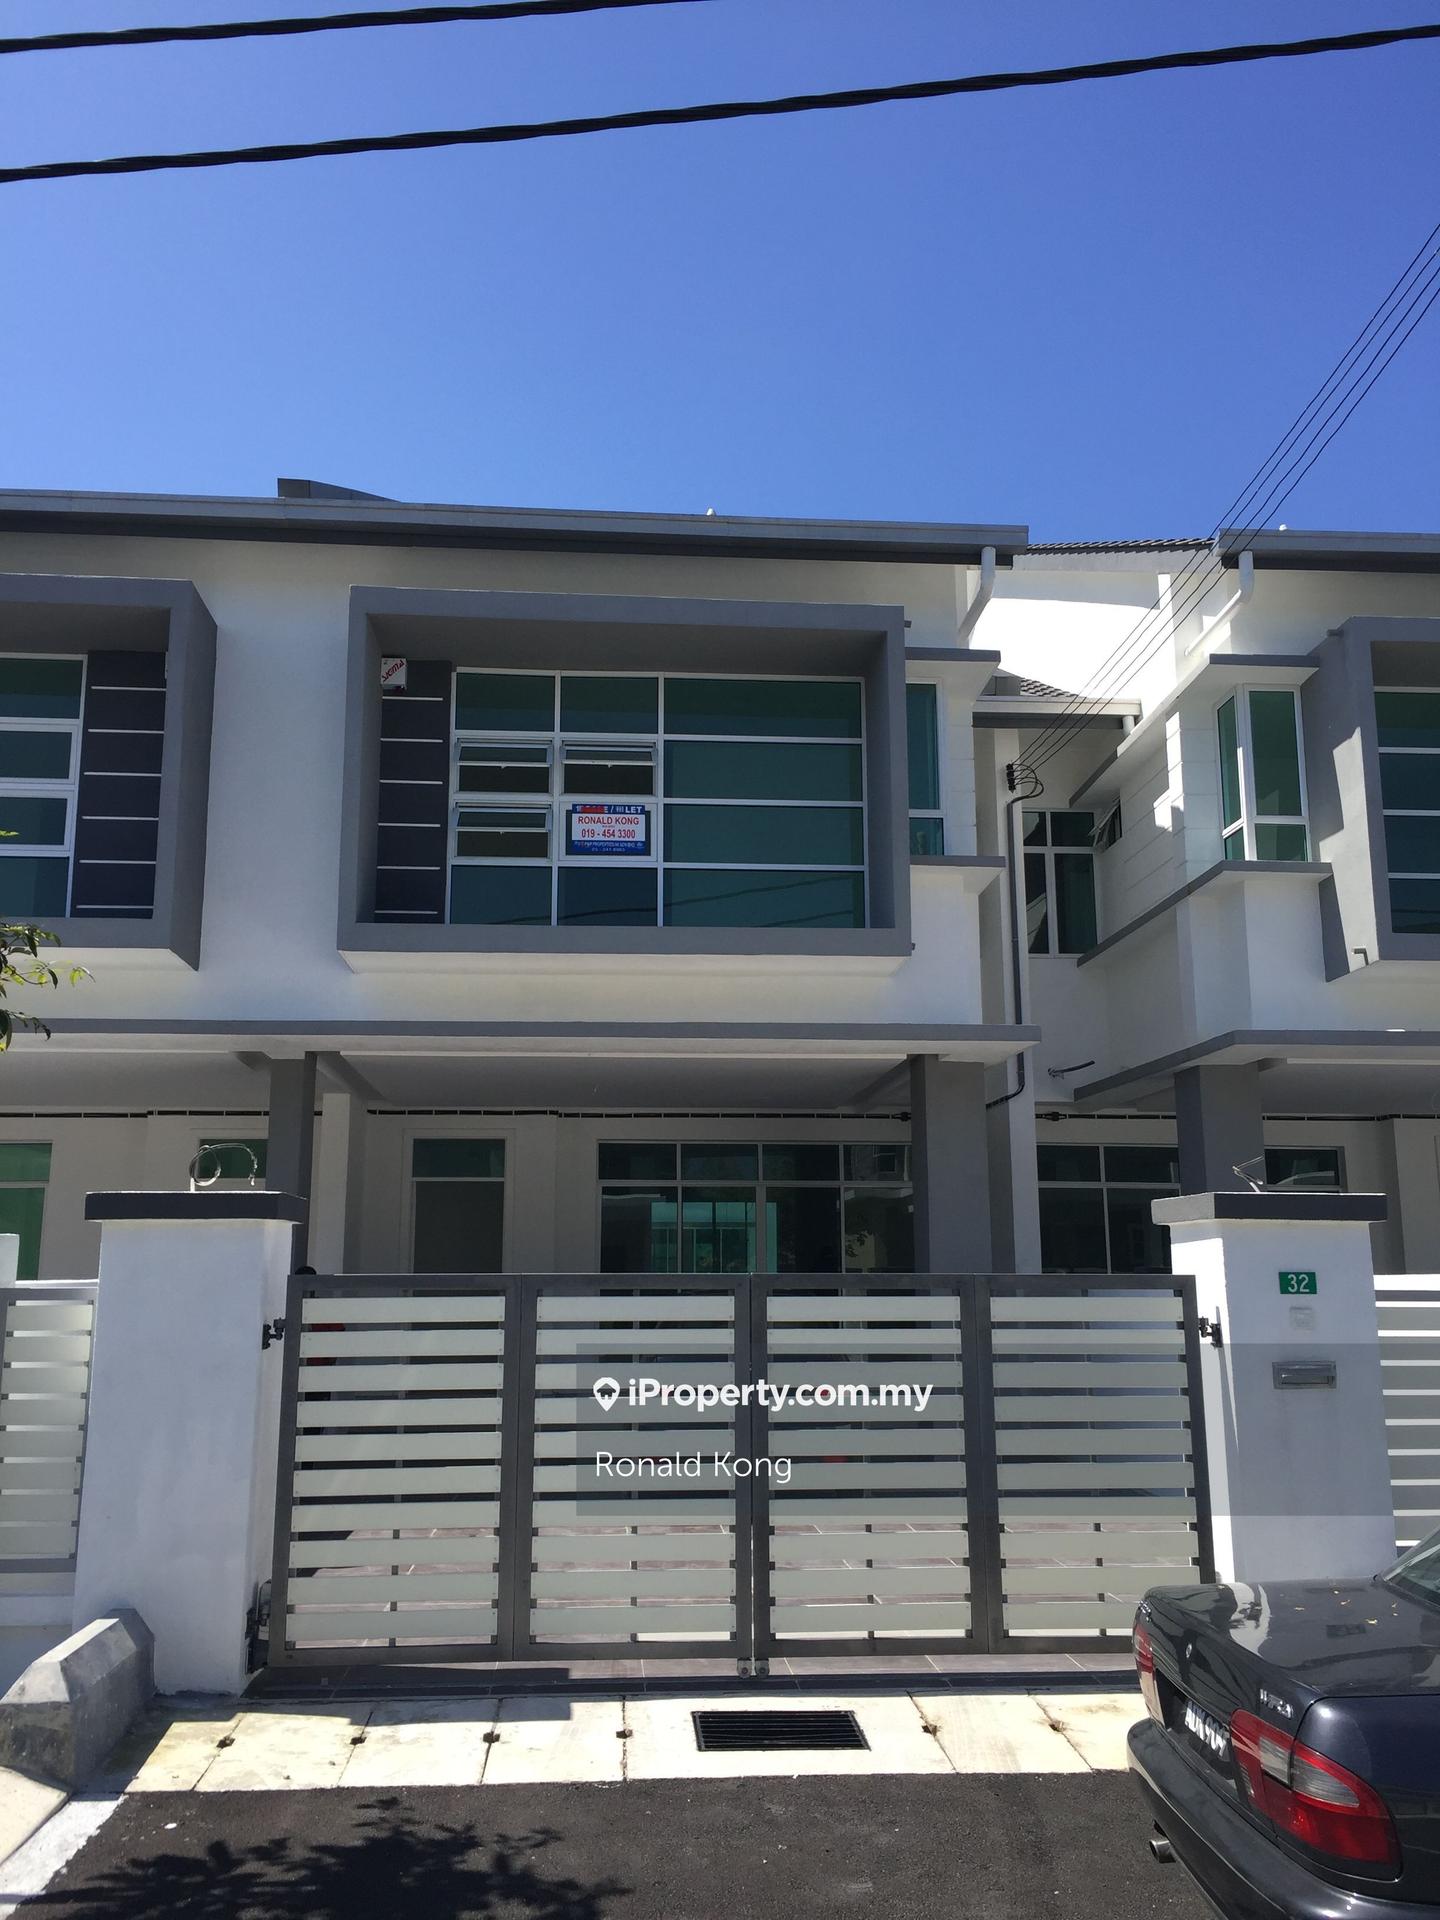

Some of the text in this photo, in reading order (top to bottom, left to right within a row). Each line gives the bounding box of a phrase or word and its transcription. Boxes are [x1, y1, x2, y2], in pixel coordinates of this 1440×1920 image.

[578, 816, 640, 825] RONALD KONG
[581, 828, 595, 838] 019
[602, 828, 616, 838] 454
[618, 829, 636, 839] 3300
[1287, 1273, 1310, 1293] 32
